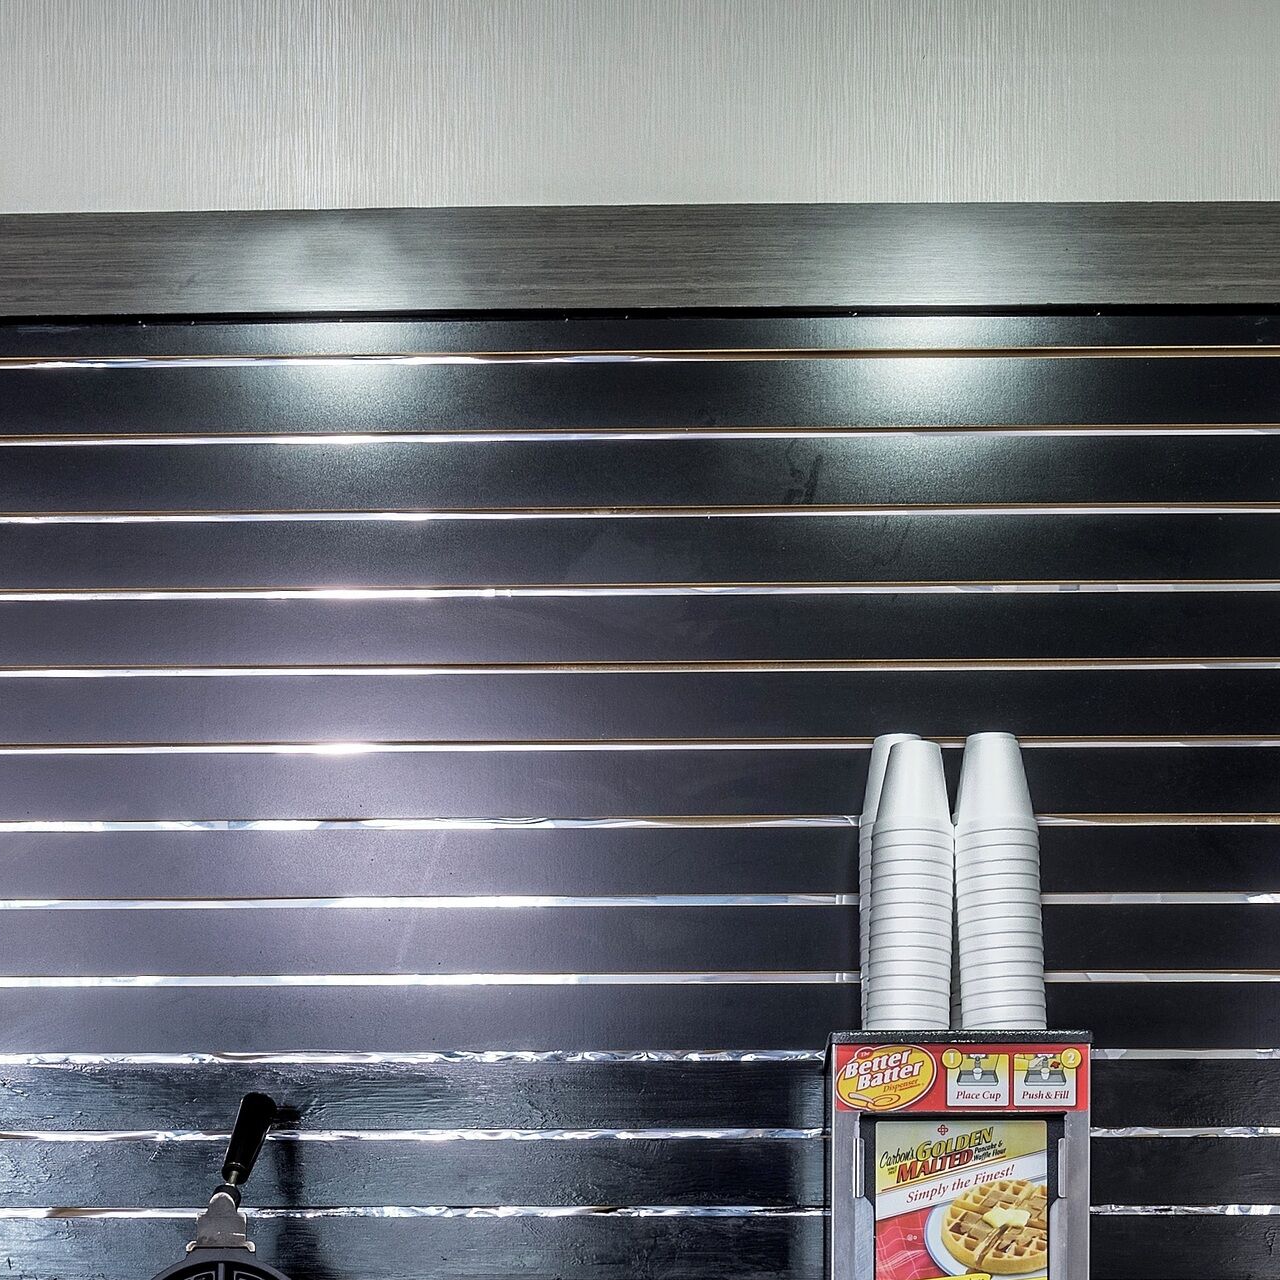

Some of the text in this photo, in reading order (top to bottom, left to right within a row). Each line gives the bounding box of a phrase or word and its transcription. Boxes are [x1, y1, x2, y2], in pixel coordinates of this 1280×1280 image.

[844, 1049, 913, 1080] Better
[1066, 1052, 1075, 1064] 2
[856, 1061, 924, 1091] Batter
[883, 1079, 919, 1093] Dispenser
[956, 1090, 1001, 1101] Place Cup
[1022, 1090, 1044, 1100] Push
[1053, 1090, 1069, 1100] Fill
[880, 1126, 994, 1168] Carbon's GOLDEN
[974, 1143, 998, 1154] Pancake
[974, 1147, 1007, 1161] Waffle Flour
[896, 1149, 974, 1184] MALTED
[906, 1164, 1015, 1204] Simply the Finest!
